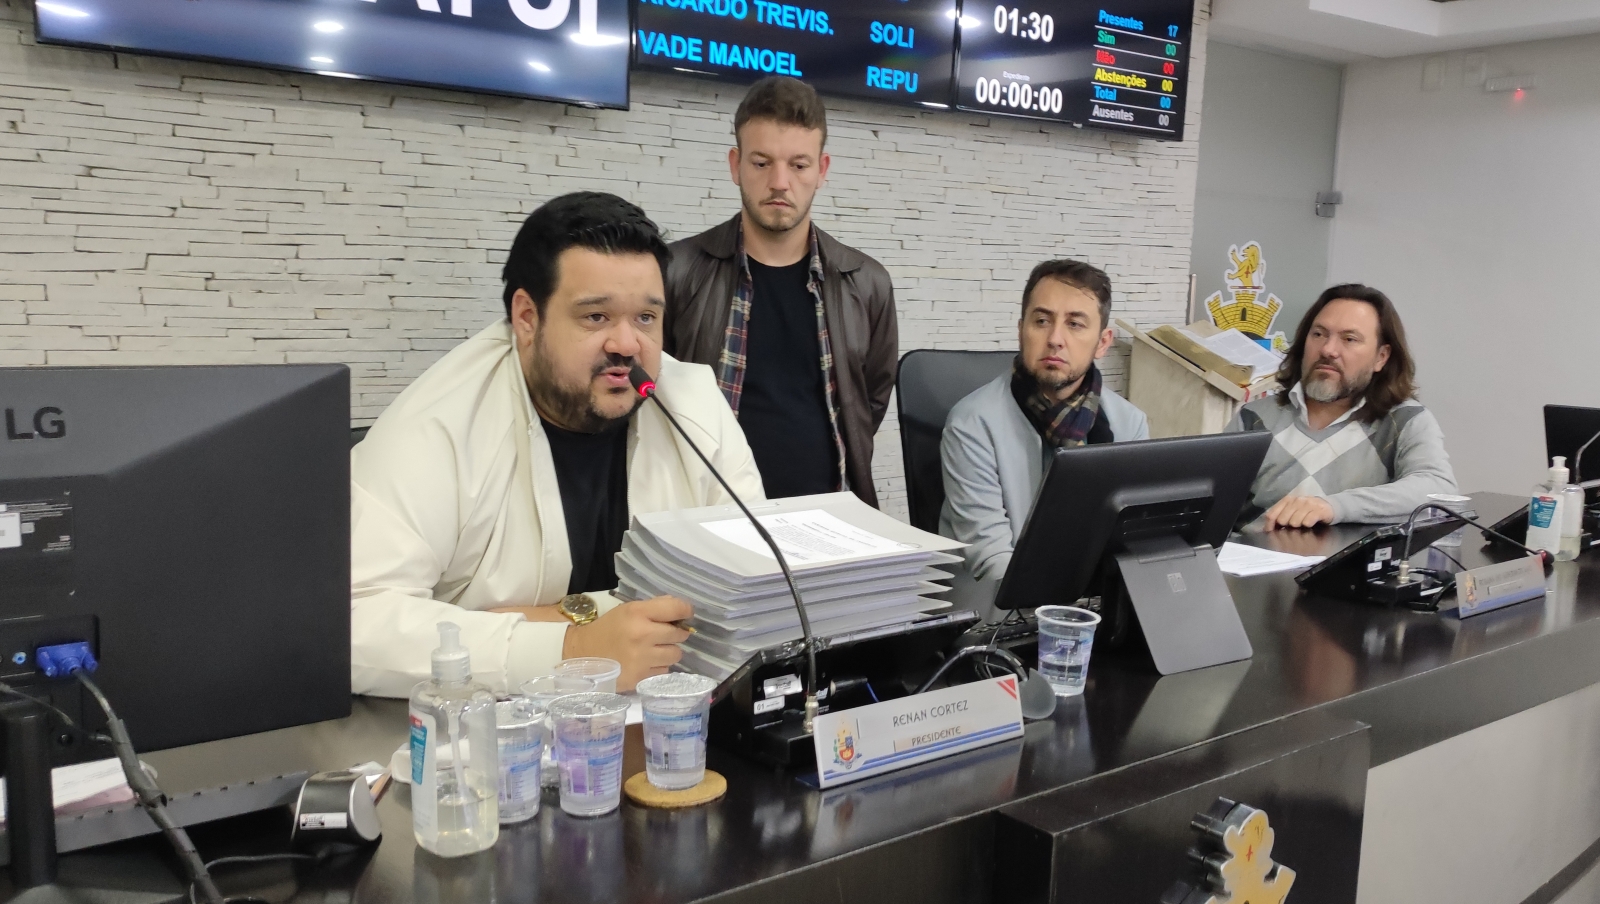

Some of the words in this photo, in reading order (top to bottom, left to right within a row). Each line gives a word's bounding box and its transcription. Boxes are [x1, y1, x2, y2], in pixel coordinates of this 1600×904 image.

[753, 0, 834, 36] TREVIS.
[993, 5, 1055, 43] 01:30
[1098, 9, 1144, 31] Presentes
[1167, 24, 1179, 38] 17
[870, 20, 915, 49] SOLI
[1097, 29, 1116, 45] Sim
[1165, 43, 1177, 57] 00
[638, 29, 703, 63] VADE
[708, 40, 803, 78] MANOEL
[1096, 49, 1116, 65] Não
[1163, 61, 1175, 76] 00
[866, 65, 919, 94] REPU
[1094, 67, 1147, 89] Abstenções
[1161, 79, 1174, 93] 00
[975, 76, 1063, 114] 00:00:00
[1094, 85, 1117, 101] Total
[1160, 96, 1172, 109] 00
[1092, 104, 1134, 122] Ausentes
[1158, 114, 1170, 127] 00
[5, 406, 67, 440] LG
[892, 709, 928, 728] RENAN
[930, 699, 969, 718] CORTEZ
[911, 726, 962, 747] PRESIDENTE
